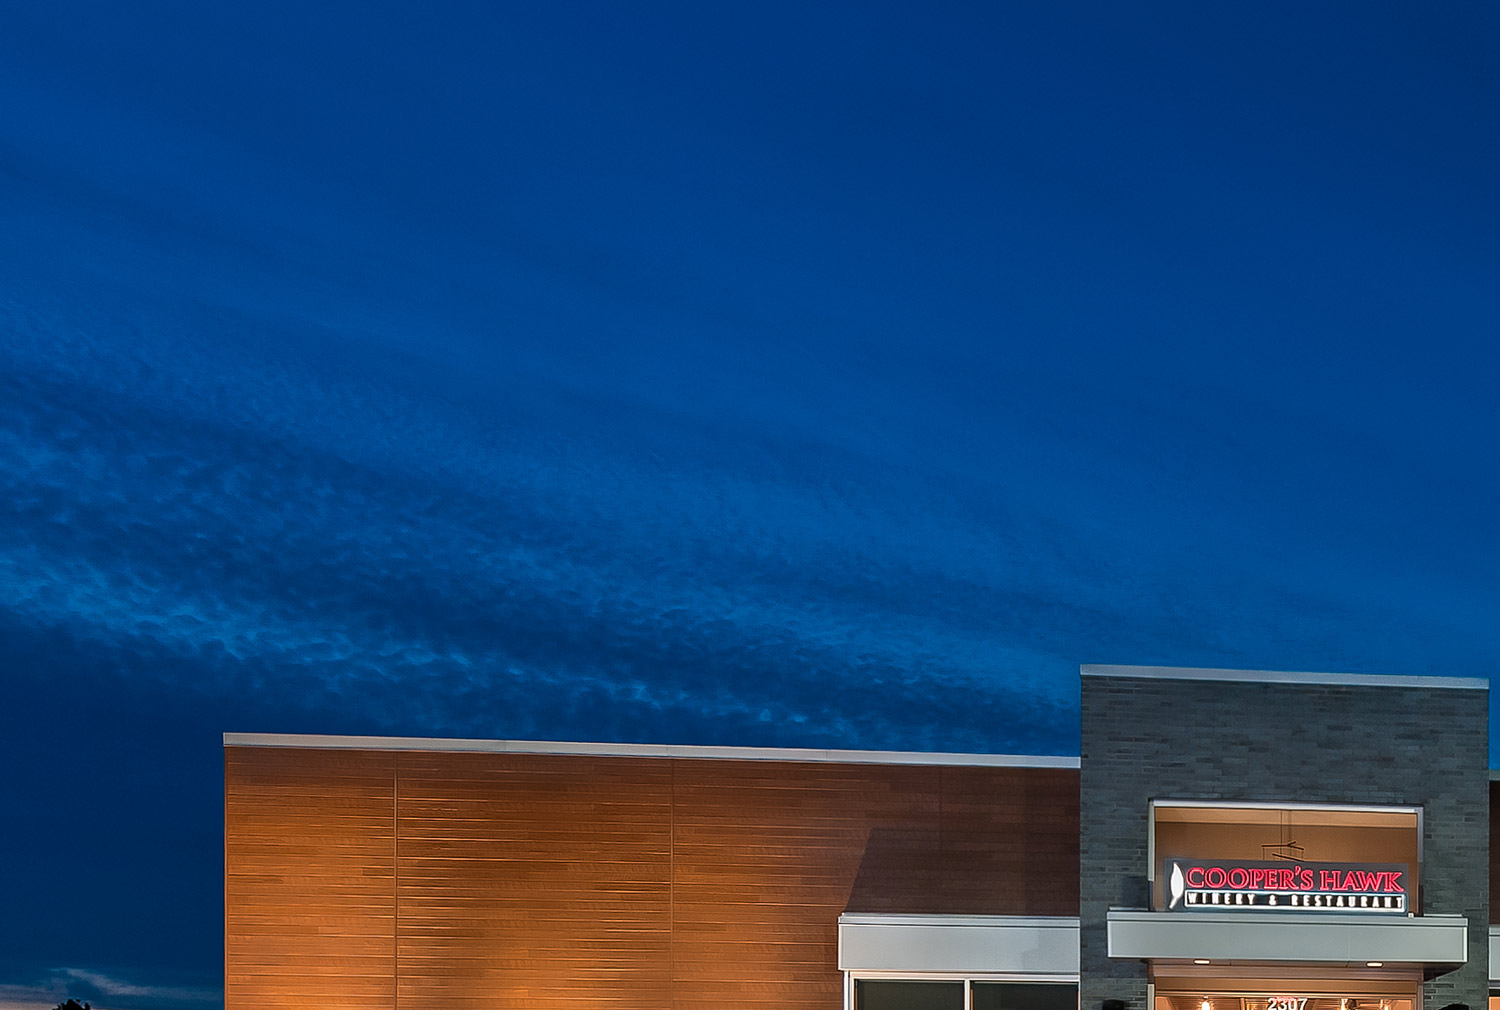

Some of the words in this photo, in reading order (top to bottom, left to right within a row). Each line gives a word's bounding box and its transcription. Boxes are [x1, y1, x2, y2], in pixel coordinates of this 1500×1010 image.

[1186, 865, 1314, 891] COOPER'S
[1319, 870, 1405, 893] HAWK
[1187, 892, 1256, 906] WINERY
[1268, 894, 1278, 906] &
[1291, 895, 1403, 909] RESTAURANT
